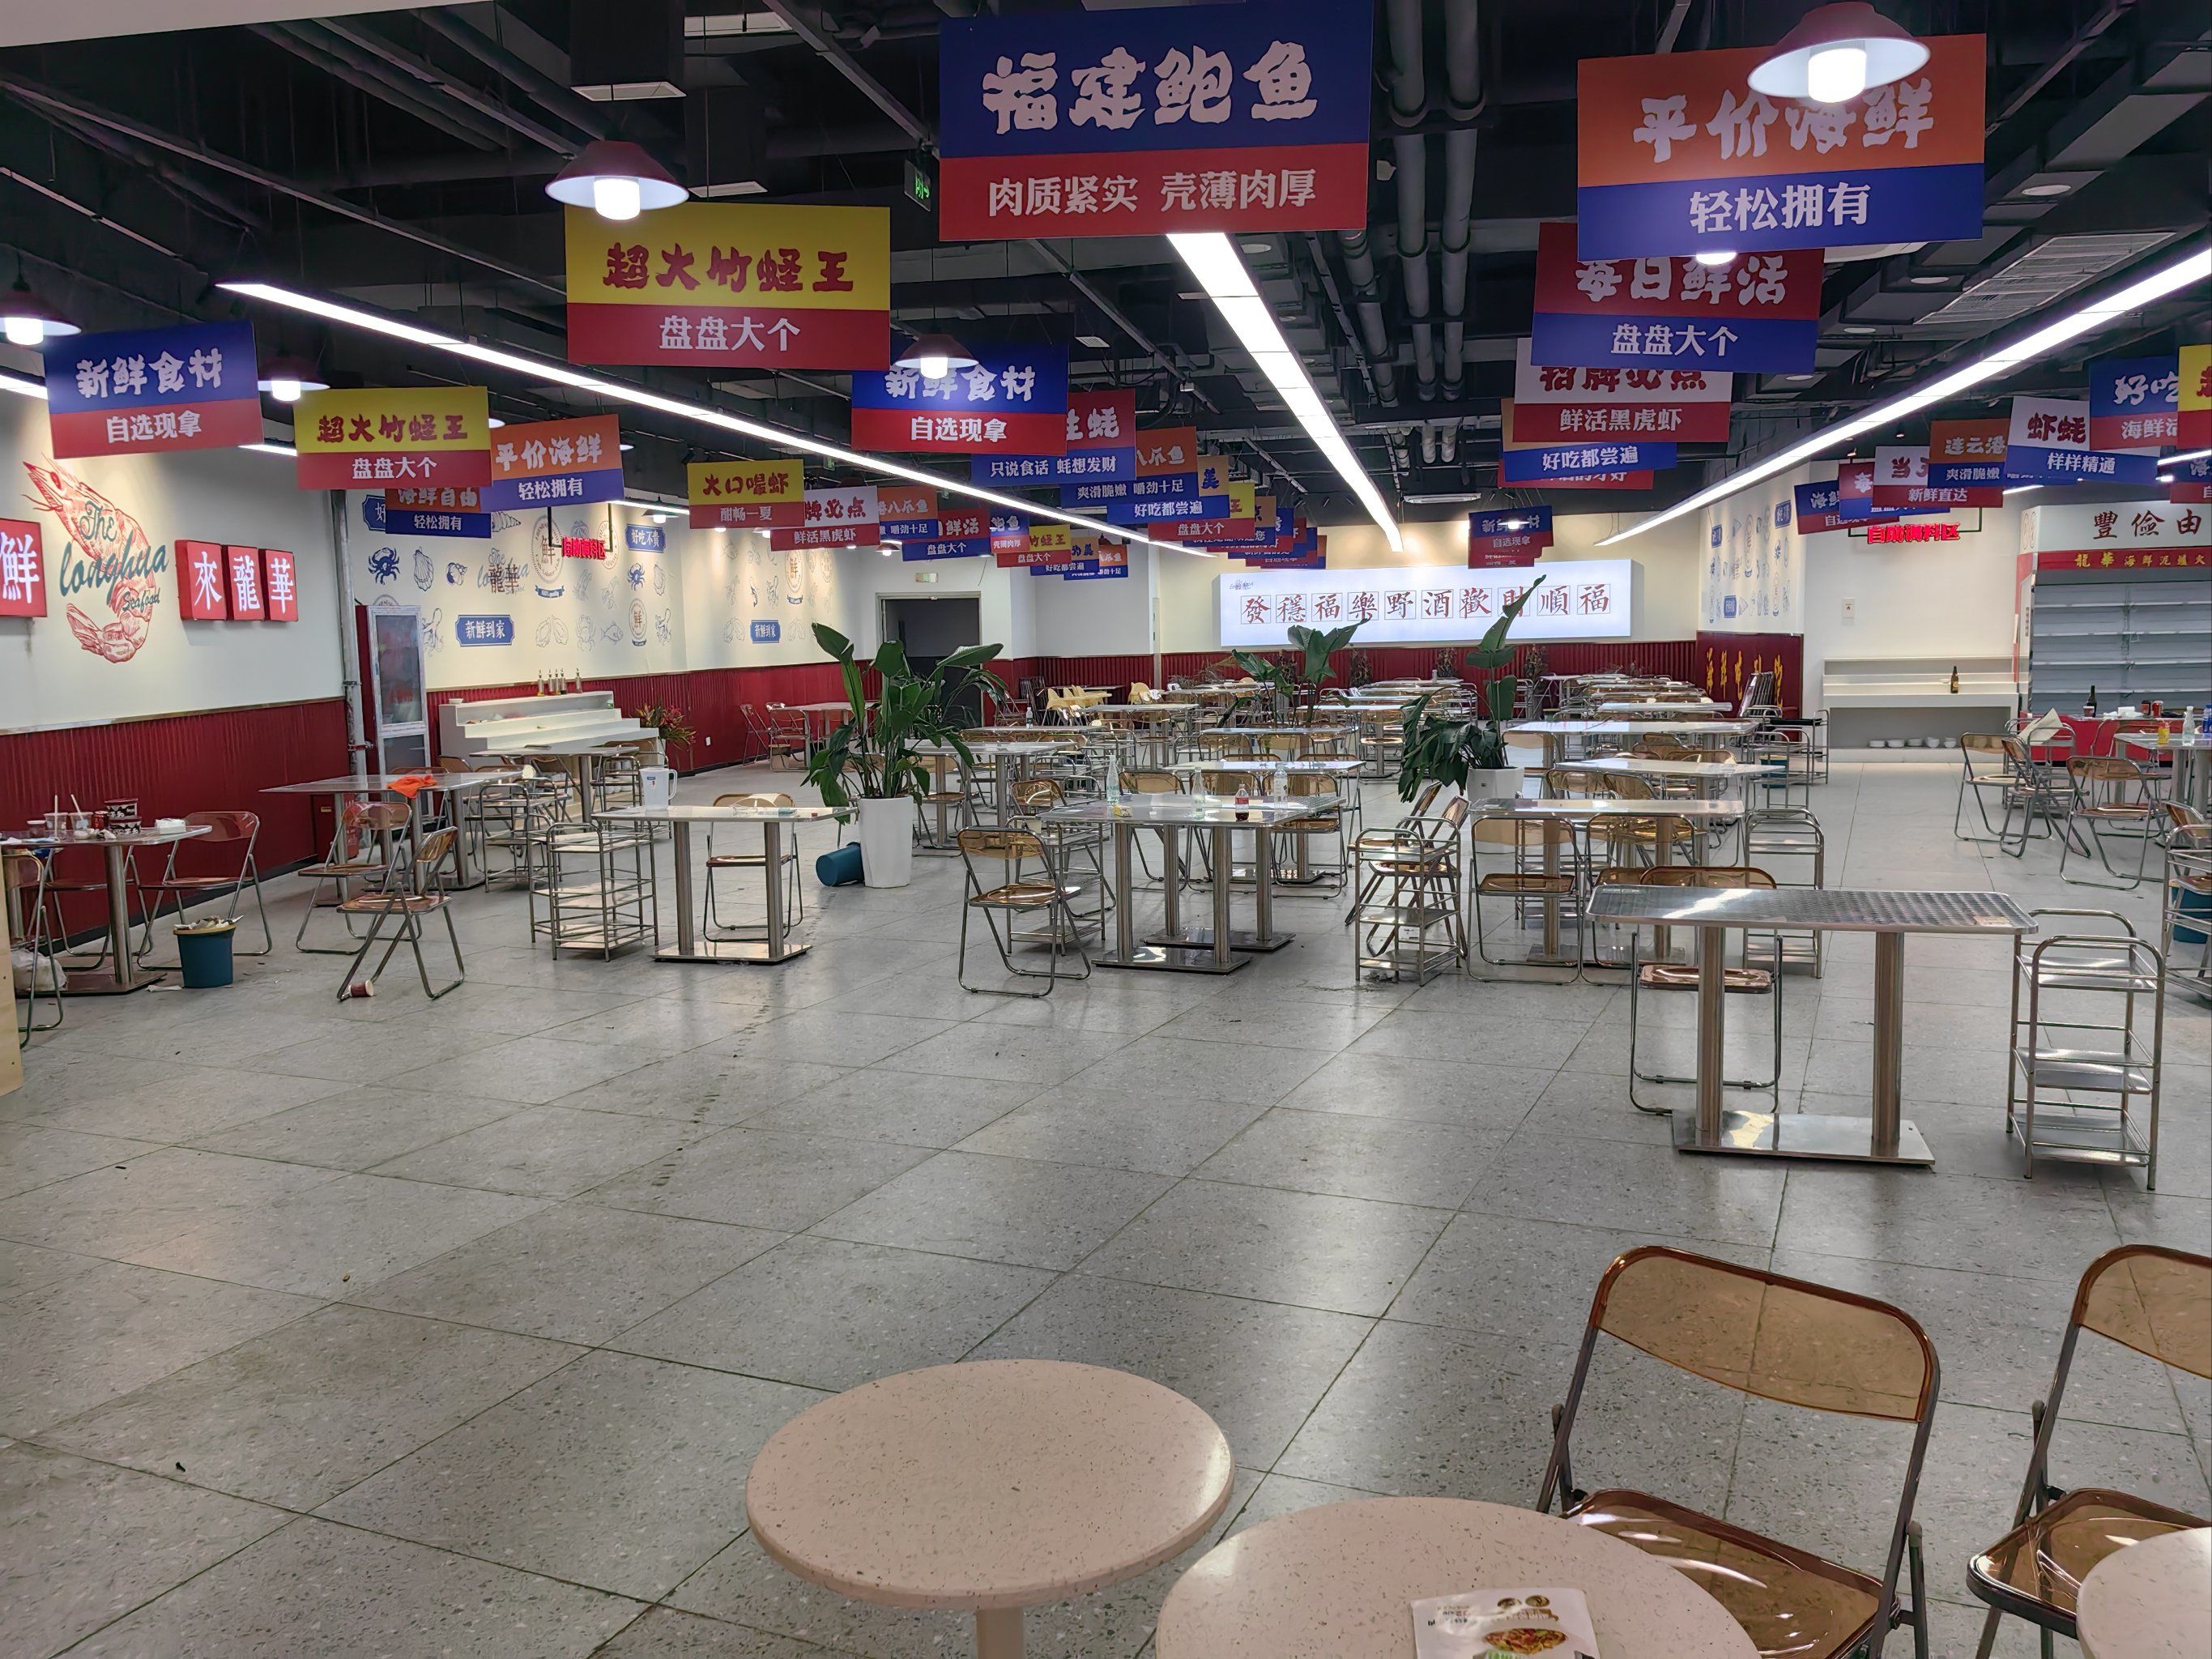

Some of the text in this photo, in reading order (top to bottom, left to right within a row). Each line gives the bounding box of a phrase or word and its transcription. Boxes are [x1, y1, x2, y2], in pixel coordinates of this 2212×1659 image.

[982, 41, 1318, 134] 福建鲍鱼
[1633, 78, 1934, 163] 平价海鲜
[989, 168, 1316, 217] 肉质紧实 壳薄肉厚
[1690, 181, 1871, 233] 轻松拥有
[603, 242, 854, 292] 超大竹蛏王
[1575, 254, 1788, 305] 每日鲜活
[658, 315, 801, 352] 盘盘大个
[1610, 323, 1738, 357] 盘盘大个
[76, 348, 223, 399] 新鲜食材
[884, 364, 1036, 401] 新鲜食材
[106, 410, 202, 443] 自选现拿
[317, 413, 468, 443] 超大竹蛏王
[910, 416, 1008, 442] 自选现拿
[1560, 408, 1682, 432] 鲜活黑虎虾
[495, 433, 603, 471] 平价海鲜
[1945, 435, 2006, 455] 连云港
[352, 456, 437, 480] 盘盘大个
[990, 456, 1117, 478] 只说食话 蚝想发财
[1542, 445, 1639, 471] 好吃都尝遍
[2047, 452, 2116, 475] 样样精通
[1946, 467, 2000, 481] 爽滑脆嫩
[518, 477, 583, 501] 轻松拥有
[1077, 479, 1184, 500] 爽滑脆嫩 嚼劲十足
[1908, 488, 1967, 502] 新鲜直达
[80, 501, 118, 542] The
[719, 505, 773, 522] 酣畅一夏
[1134, 500, 1204, 518] 好吃都尝遍
[414, 514, 462, 531] 轻松拥有
[1178, 522, 1225, 536] 盘盘大个
[1867, 522, 1961, 544] 自助调料区
[794, 527, 857, 544] 鲜活黑虎虾
[1492, 535, 1531, 548] 自选现拿
[927, 542, 967, 556] 盘盘大个
[1017, 552, 1051, 563] 盘盘大个
[59, 531, 169, 604] longhua
[121, 587, 160, 614] Seafood
